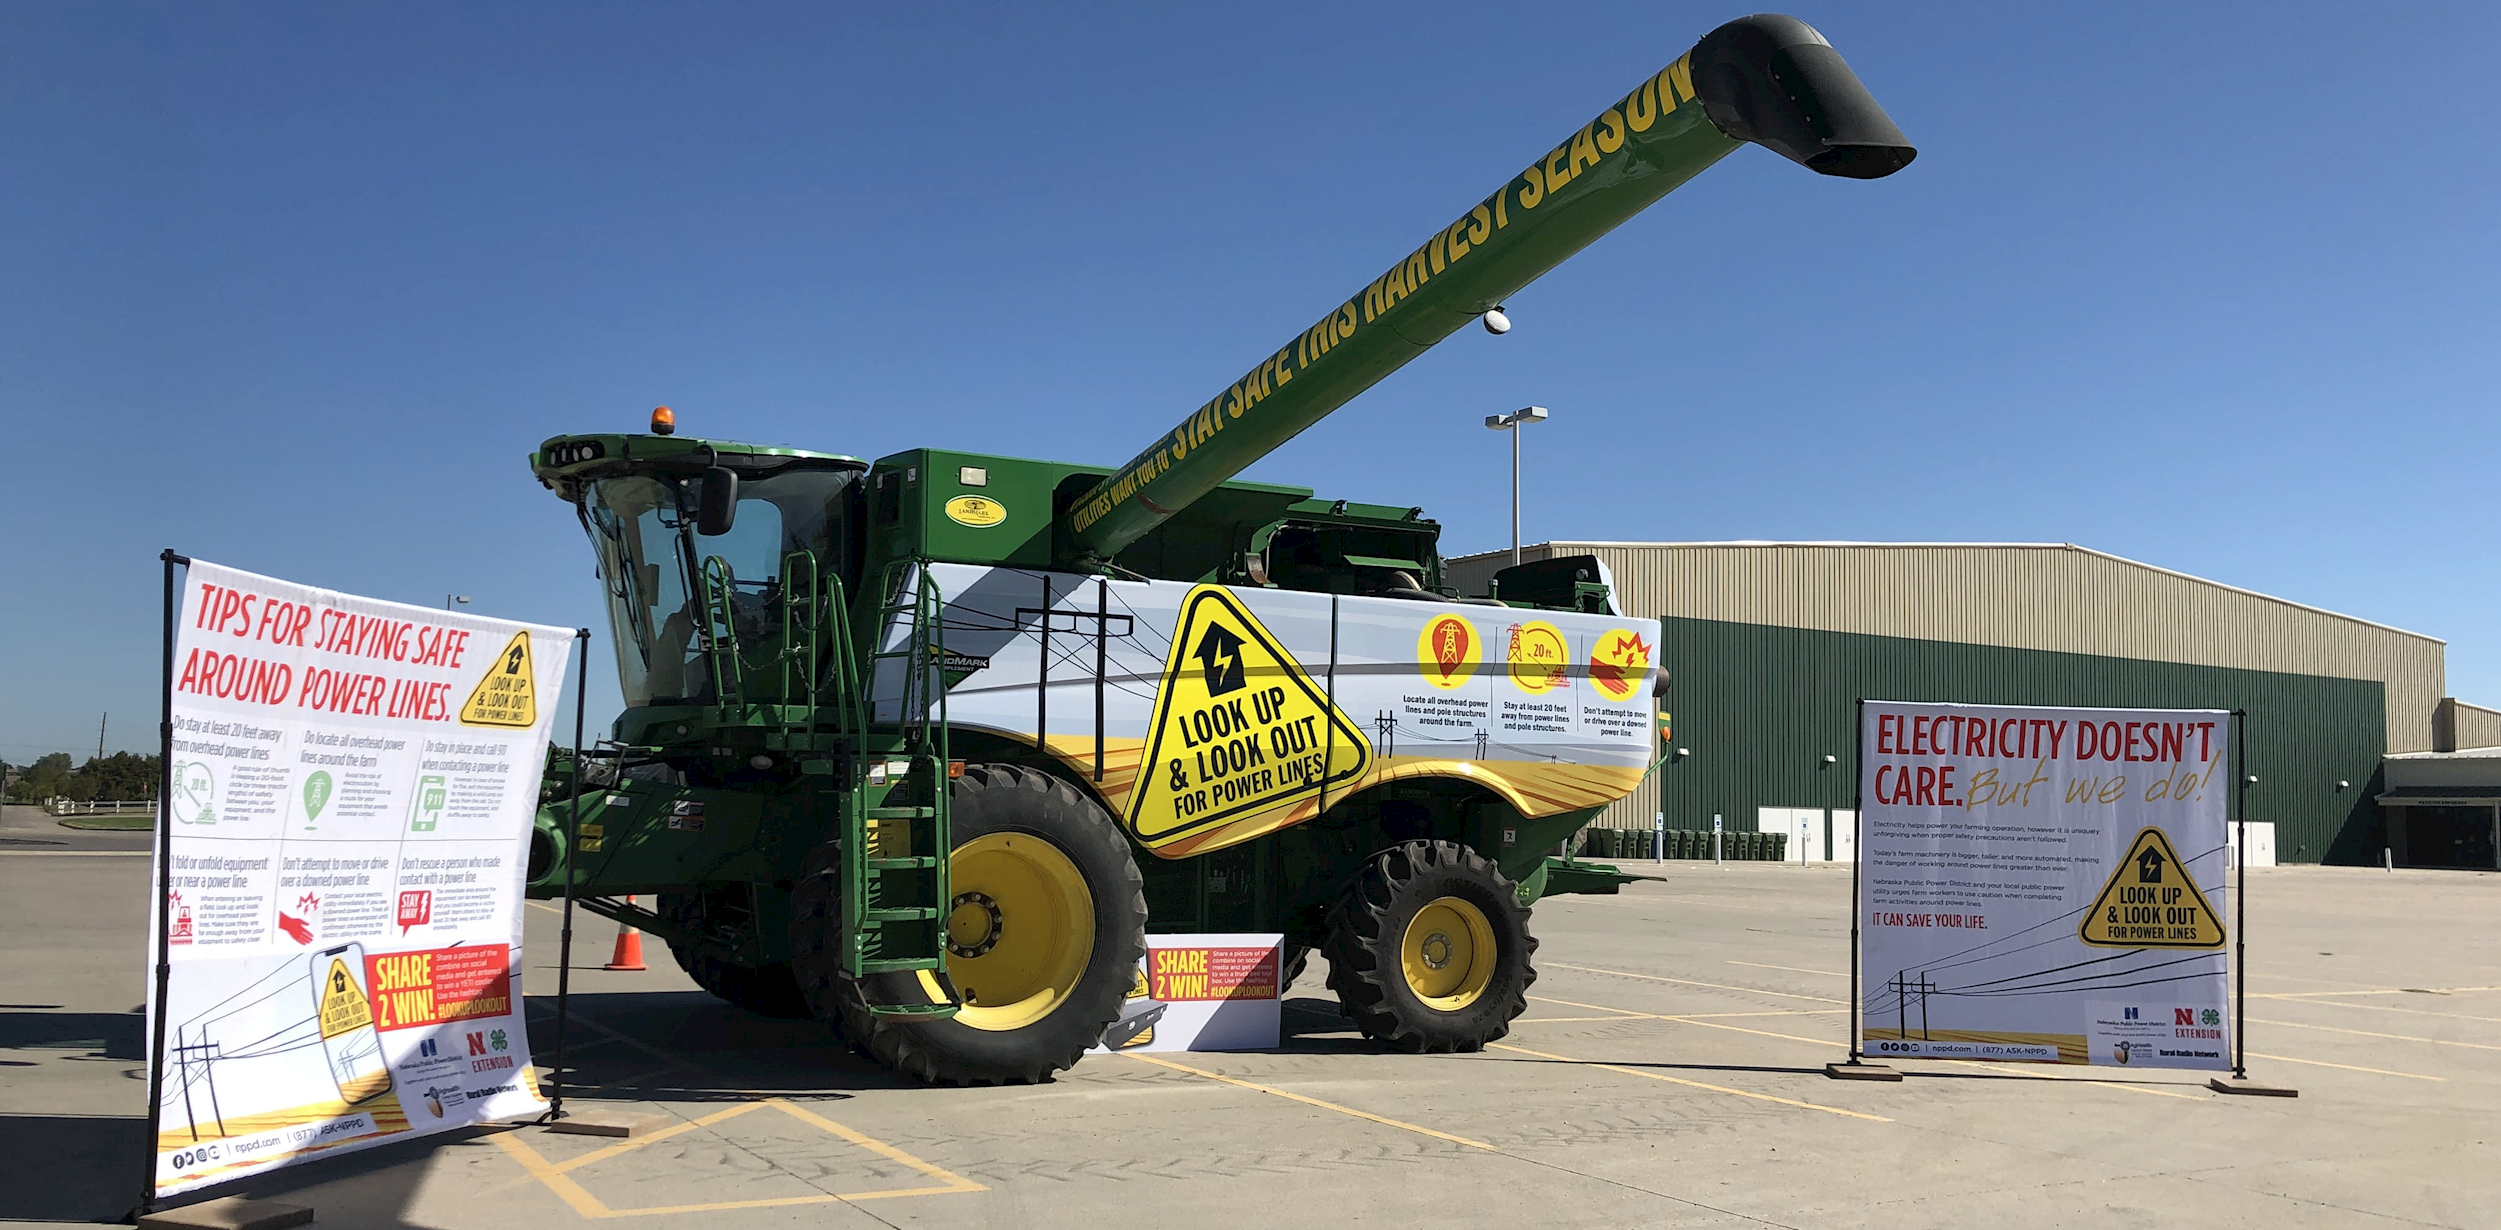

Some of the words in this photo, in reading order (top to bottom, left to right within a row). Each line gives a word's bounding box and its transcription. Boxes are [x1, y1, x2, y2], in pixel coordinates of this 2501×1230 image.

[1073, 491, 1111, 533] UTILITIES
[1109, 474, 1137, 506] WANT
[1136, 457, 1156, 487] YOU
[1155, 448, 1170, 474] TO
[1172, 392, 1226, 460] STAY
[1228, 347, 1293, 419] SAFE
[1298, 296, 1357, 370] THIS
[1364, 181, 1511, 324] HARVEST
[1519, 49, 1695, 209] SEASON
[196, 583, 256, 637] TIPS
[256, 598, 312, 647] FOR
[313, 608, 413, 662] STAYING
[411, 626, 469, 668] SAFE
[1533, 643, 1544, 657] 20
[1545, 648, 1554, 658] ft.
[178, 647, 293, 705] AROUND
[298, 666, 386, 716] POWER
[387, 679, 452, 722] LINES.
[490, 676, 512, 692] LOOK
[513, 679, 526, 692] UP
[477, 692, 484, 706] &
[488, 693, 509, 708] LOOK
[511, 695, 529, 710] OUT
[1403, 695, 1426, 704] Locate
[1437, 698, 1467, 707] overhead
[1469, 700, 1488, 708] power
[1504, 701, 1518, 711] Stay
[1527, 703, 1543, 711] least
[1544, 704, 1553, 712] 20
[1554, 705, 1567, 713] feet
[473, 708, 485, 719] FOR
[488, 709, 507, 720] POWER
[508, 711, 524, 721] LINES
[1178, 698, 1250, 749] LOOK
[1251, 686, 1285, 725] UP
[1405, 705, 1421, 714] lines
[1423, 706, 1435, 715] and
[1437, 707, 1451, 716] pole
[1453, 709, 1486, 718] structures
[1501, 712, 1517, 721] away
[1534, 714, 1553, 723] power
[1554, 715, 1570, 723] lines
[1584, 706, 1600, 715] Don't
[1601, 708, 1626, 717] attempt
[173, 714, 184, 730] Do
[186, 717, 201, 734] stay
[202, 720, 211, 734] at
[212, 720, 231, 736] least
[231, 723, 242, 737] 20
[242, 724, 258, 739] feet
[258, 729, 282, 743] away
[1419, 717, 1442, 726] around
[1444, 718, 1455, 726] the
[1456, 718, 1474, 727] farm.
[1504, 722, 1516, 730] and
[1517, 723, 1531, 732] pole
[1532, 724, 1567, 733] structures.
[1591, 717, 1606, 725] drive
[1627, 720, 1647, 728] downed
[304, 730, 314, 744] Do
[315, 732, 339, 746] locate
[340, 734, 350, 747] all
[350, 736, 384, 749] overhead
[383, 738, 406, 752] power
[1620, 729, 1633, 737] line.
[1878, 714, 2067, 759] ELECTRICITY
[2076, 721, 2214, 762] DOESN'T
[171, 736, 189, 752] from
[190, 740, 225, 756] overhead
[224, 745, 250, 759] power
[250, 746, 270, 760] lines
[1169, 758, 1189, 792] &
[1193, 732, 1266, 784] LOOK
[1270, 715, 1319, 759] OUT
[300, 749, 317, 764] lines
[318, 752, 346, 766] around
[346, 754, 359, 767] the
[359, 754, 377, 767] farm
[1174, 790, 1207, 819] FOR
[1213, 771, 1273, 806] POWER
[1279, 753, 1325, 786] LINES
[1875, 765, 1963, 806] CARE.
[1967, 755, 2049, 813] But
[2065, 775, 2126, 804] we
[2145, 749, 2221, 803] do!
[427, 793, 443, 806] 911
[1873, 821, 1906, 829] Electricity
[1908, 822, 1925, 830] helps
[1964, 824, 1990, 832] farming
[1992, 825, 2026, 833] operation,
[2071, 827, 2100, 835] uniquely
[1873, 831, 1910, 839] unforgiving
[1956, 832, 1973, 840] safety
[401, 894, 420, 908] STAY
[2120, 887, 2157, 904] LOOK
[2162, 888, 2182, 905] UP
[400, 908, 418, 919] AWAY
[1872, 912, 1880, 926] IT
[1883, 912, 1904, 927] CAN
[1906, 913, 1931, 927] SAVE
[1935, 914, 1962, 928] YOUR
[1965, 915, 1988, 929] LIFE.
[2107, 906, 2118, 923] &
[2125, 907, 2161, 924] LOOK
[2166, 907, 2196, 925] OUT
[2108, 926, 2127, 938] FOR
[2131, 926, 2164, 938] POWER
[2168, 927, 2196, 940] LINES
[1157, 950, 1208, 974] SHARE
[376, 954, 431, 991] SHARE
[1156, 977, 1165, 999] 2
[1169, 975, 1208, 998] WIN!
[1211, 985, 1274, 998] #LOOKUPLOOKOUT
[328, 995, 346, 1010] LOOK
[347, 992, 356, 1004] UP
[378, 993, 391, 1027] 2
[392, 989, 435, 1024] WIN!
[438, 996, 507, 1019] #LOOKUPLOOKOUT
[2175, 1028, 2221, 1039] EXTENSION
[1932, 1045, 1971, 1053] nppd.com
[2006, 1047, 2048, 1055] ASK-NPPD
[471, 1055, 514, 1073] EXTENSION
[235, 1137, 281, 1154] nppd.com
[319, 1118, 364, 1136] ASK-NPPD
